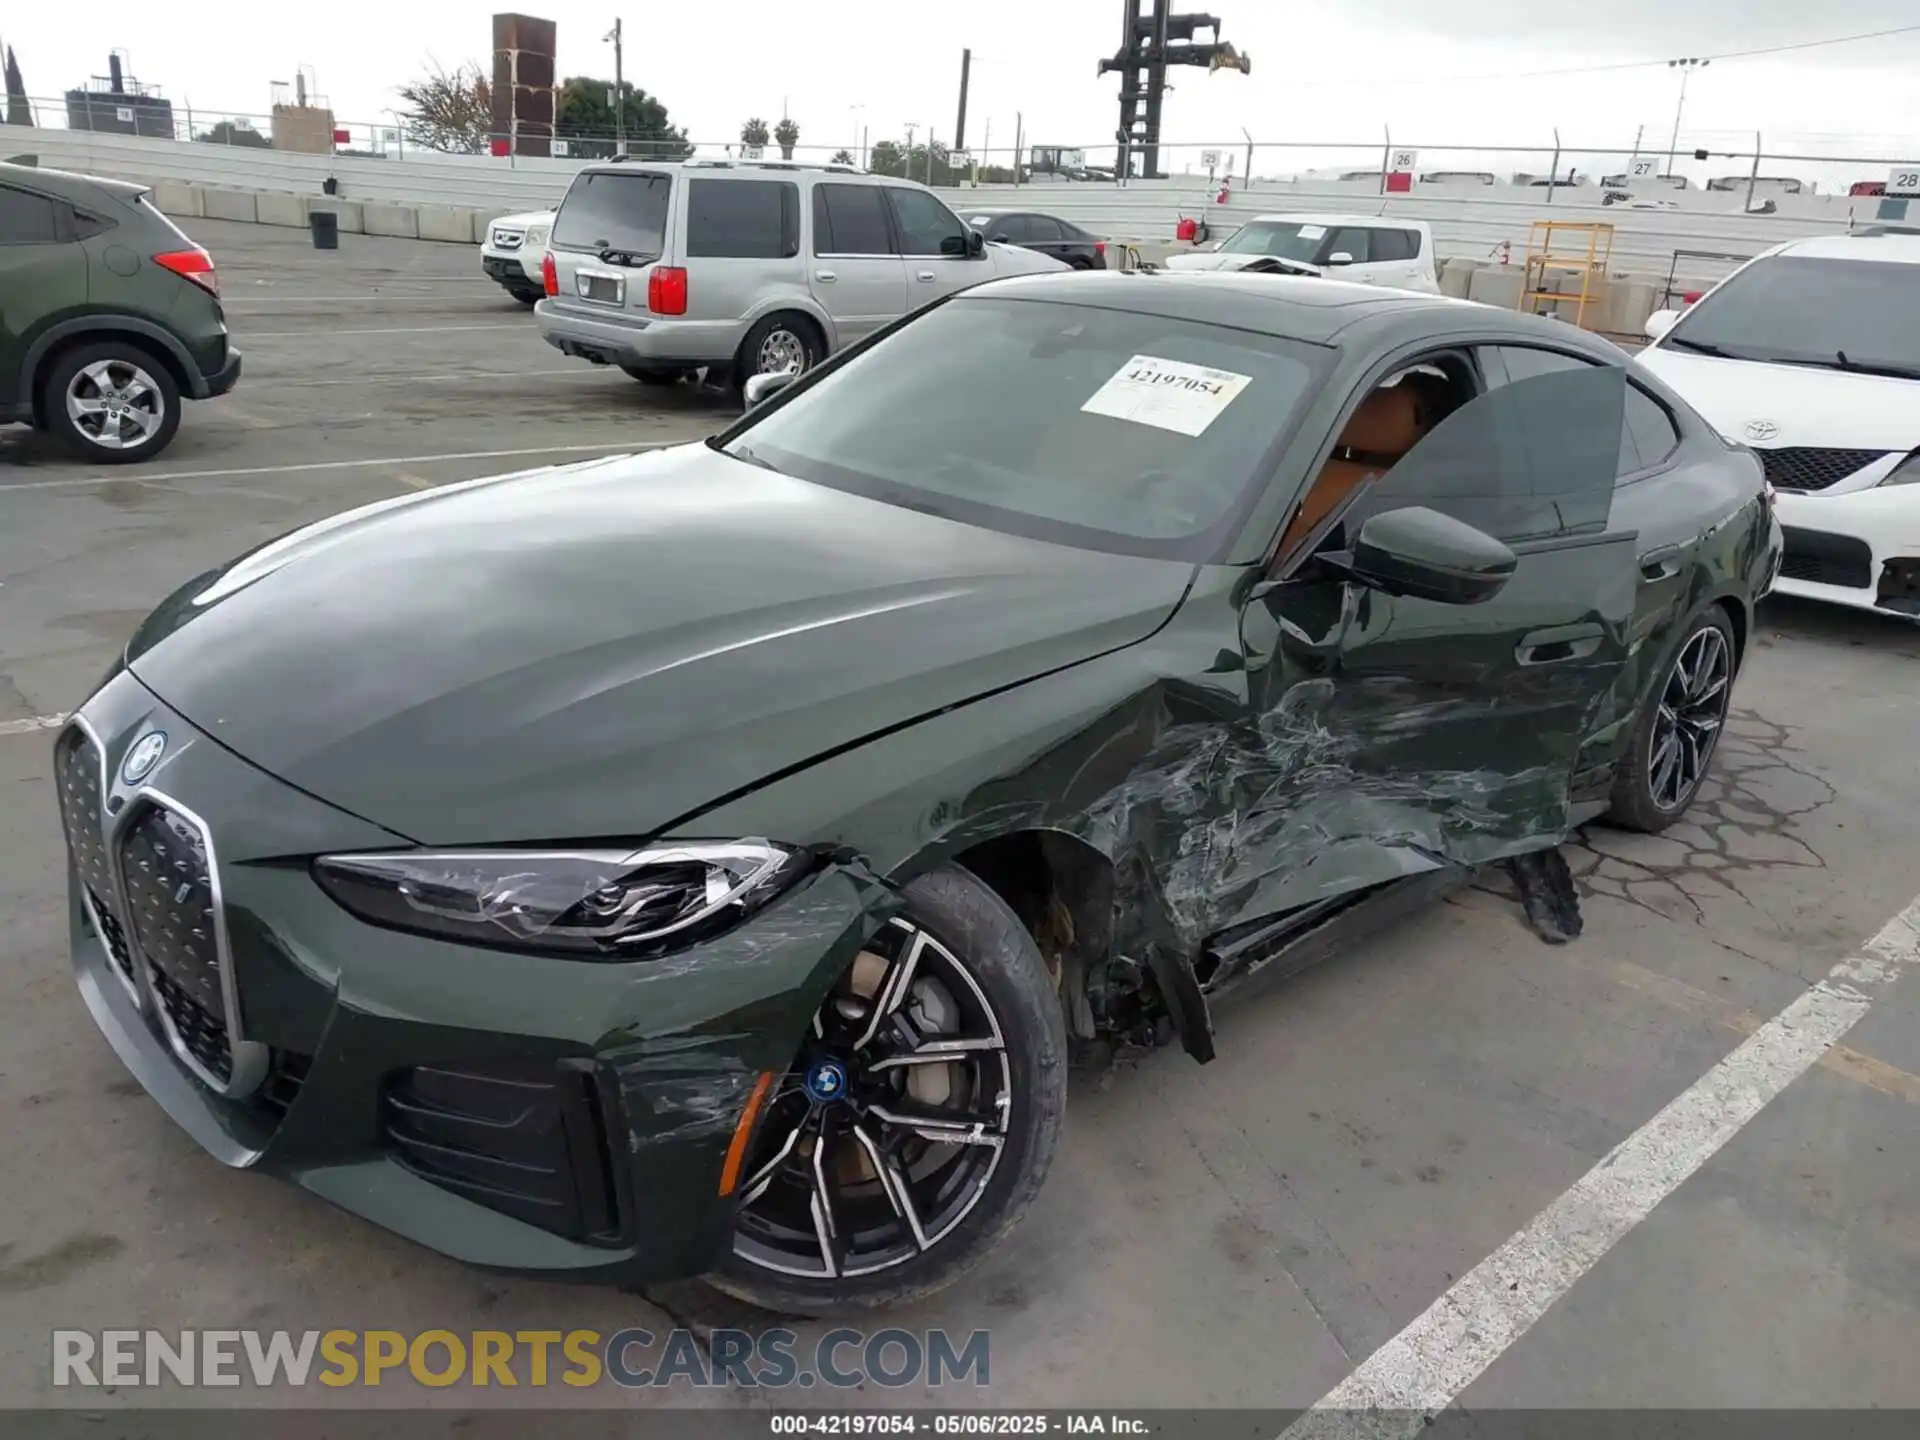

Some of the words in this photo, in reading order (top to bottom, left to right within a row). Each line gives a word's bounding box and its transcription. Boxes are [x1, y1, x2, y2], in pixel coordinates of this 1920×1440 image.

[1397, 154, 1410, 165] 26
[1634, 163, 1651, 175] 27
[1897, 174, 1918, 187] 28
[1128, 368, 1224, 396] 42197054
